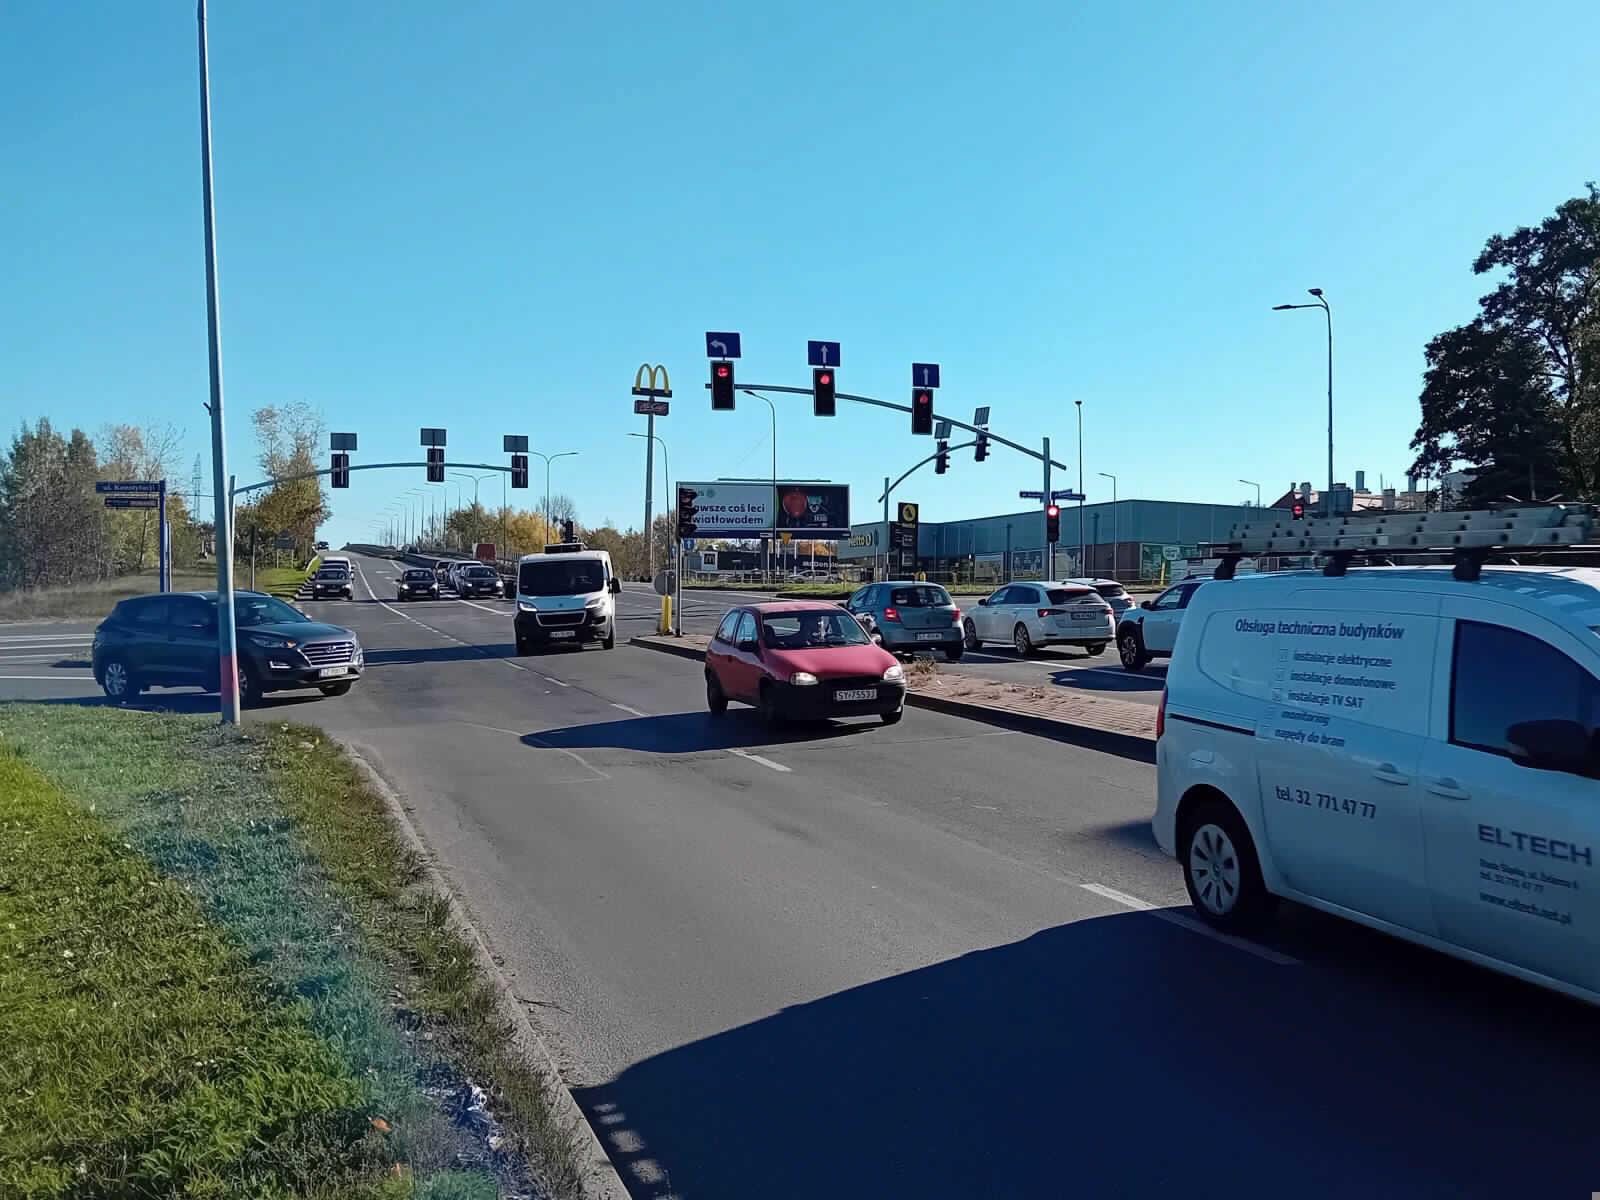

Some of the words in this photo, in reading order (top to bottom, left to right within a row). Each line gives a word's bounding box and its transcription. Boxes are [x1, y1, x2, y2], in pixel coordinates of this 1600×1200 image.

[694, 503, 726, 513] awsze
[728, 503, 744, 513] coś
[748, 503, 765, 513] leci
[693, 514, 763, 524] wiatłowodem
[1235, 618, 1276, 636] Obsługa
[1278, 621, 1336, 636] techniczna
[1339, 622, 1405, 640] budynków
[1294, 651, 1335, 665] instalacje
[1337, 653, 1393, 668] elektryczne
[1290, 671, 1332, 686] instalacje
[1334, 674, 1397, 690] domofonowe
[1288, 690, 1330, 706] instalacje
[1331, 694, 1343, 706] TV
[1343, 696, 1364, 708] SAT
[1307, 731, 1320, 743] do
[1320, 734, 1345, 747] bram
[1276, 785, 1294, 802] tel.
[1296, 789, 1312, 806] 32
[1317, 793, 1339, 812] 771
[1342, 799, 1357, 815] 47
[1360, 801, 1376, 819] 77
[1478, 823, 1592, 867] ELTECH
